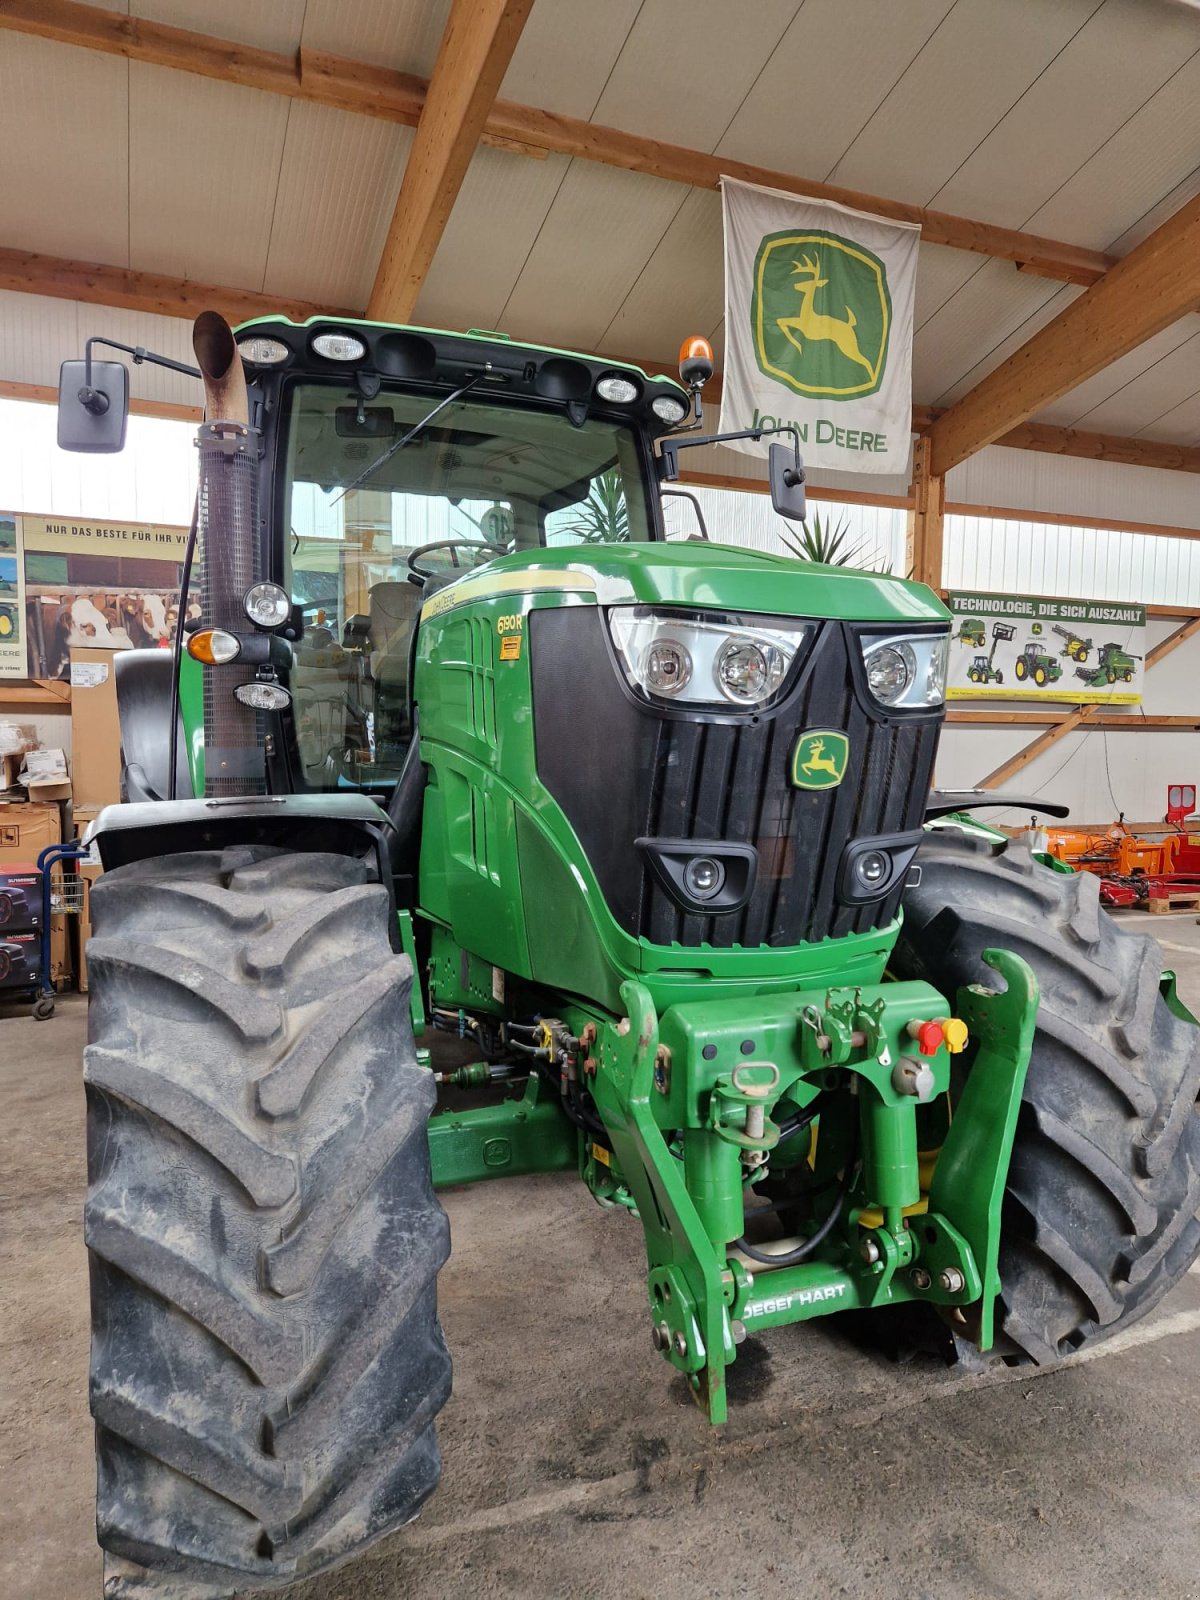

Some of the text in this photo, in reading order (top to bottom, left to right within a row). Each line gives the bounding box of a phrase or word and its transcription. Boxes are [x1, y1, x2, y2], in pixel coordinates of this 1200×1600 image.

[745, 409, 888, 453] JOHN DEERE
[46, 524, 67, 535] NUR
[71, 526, 92, 537] DAS
[96, 529, 128, 540] BESTE
[132, 530, 151, 541] FÜR
[155, 533, 172, 544] IHR
[953, 597, 1142, 622] TECHNOLOGIE, DIE SICH AUSZAHLT
